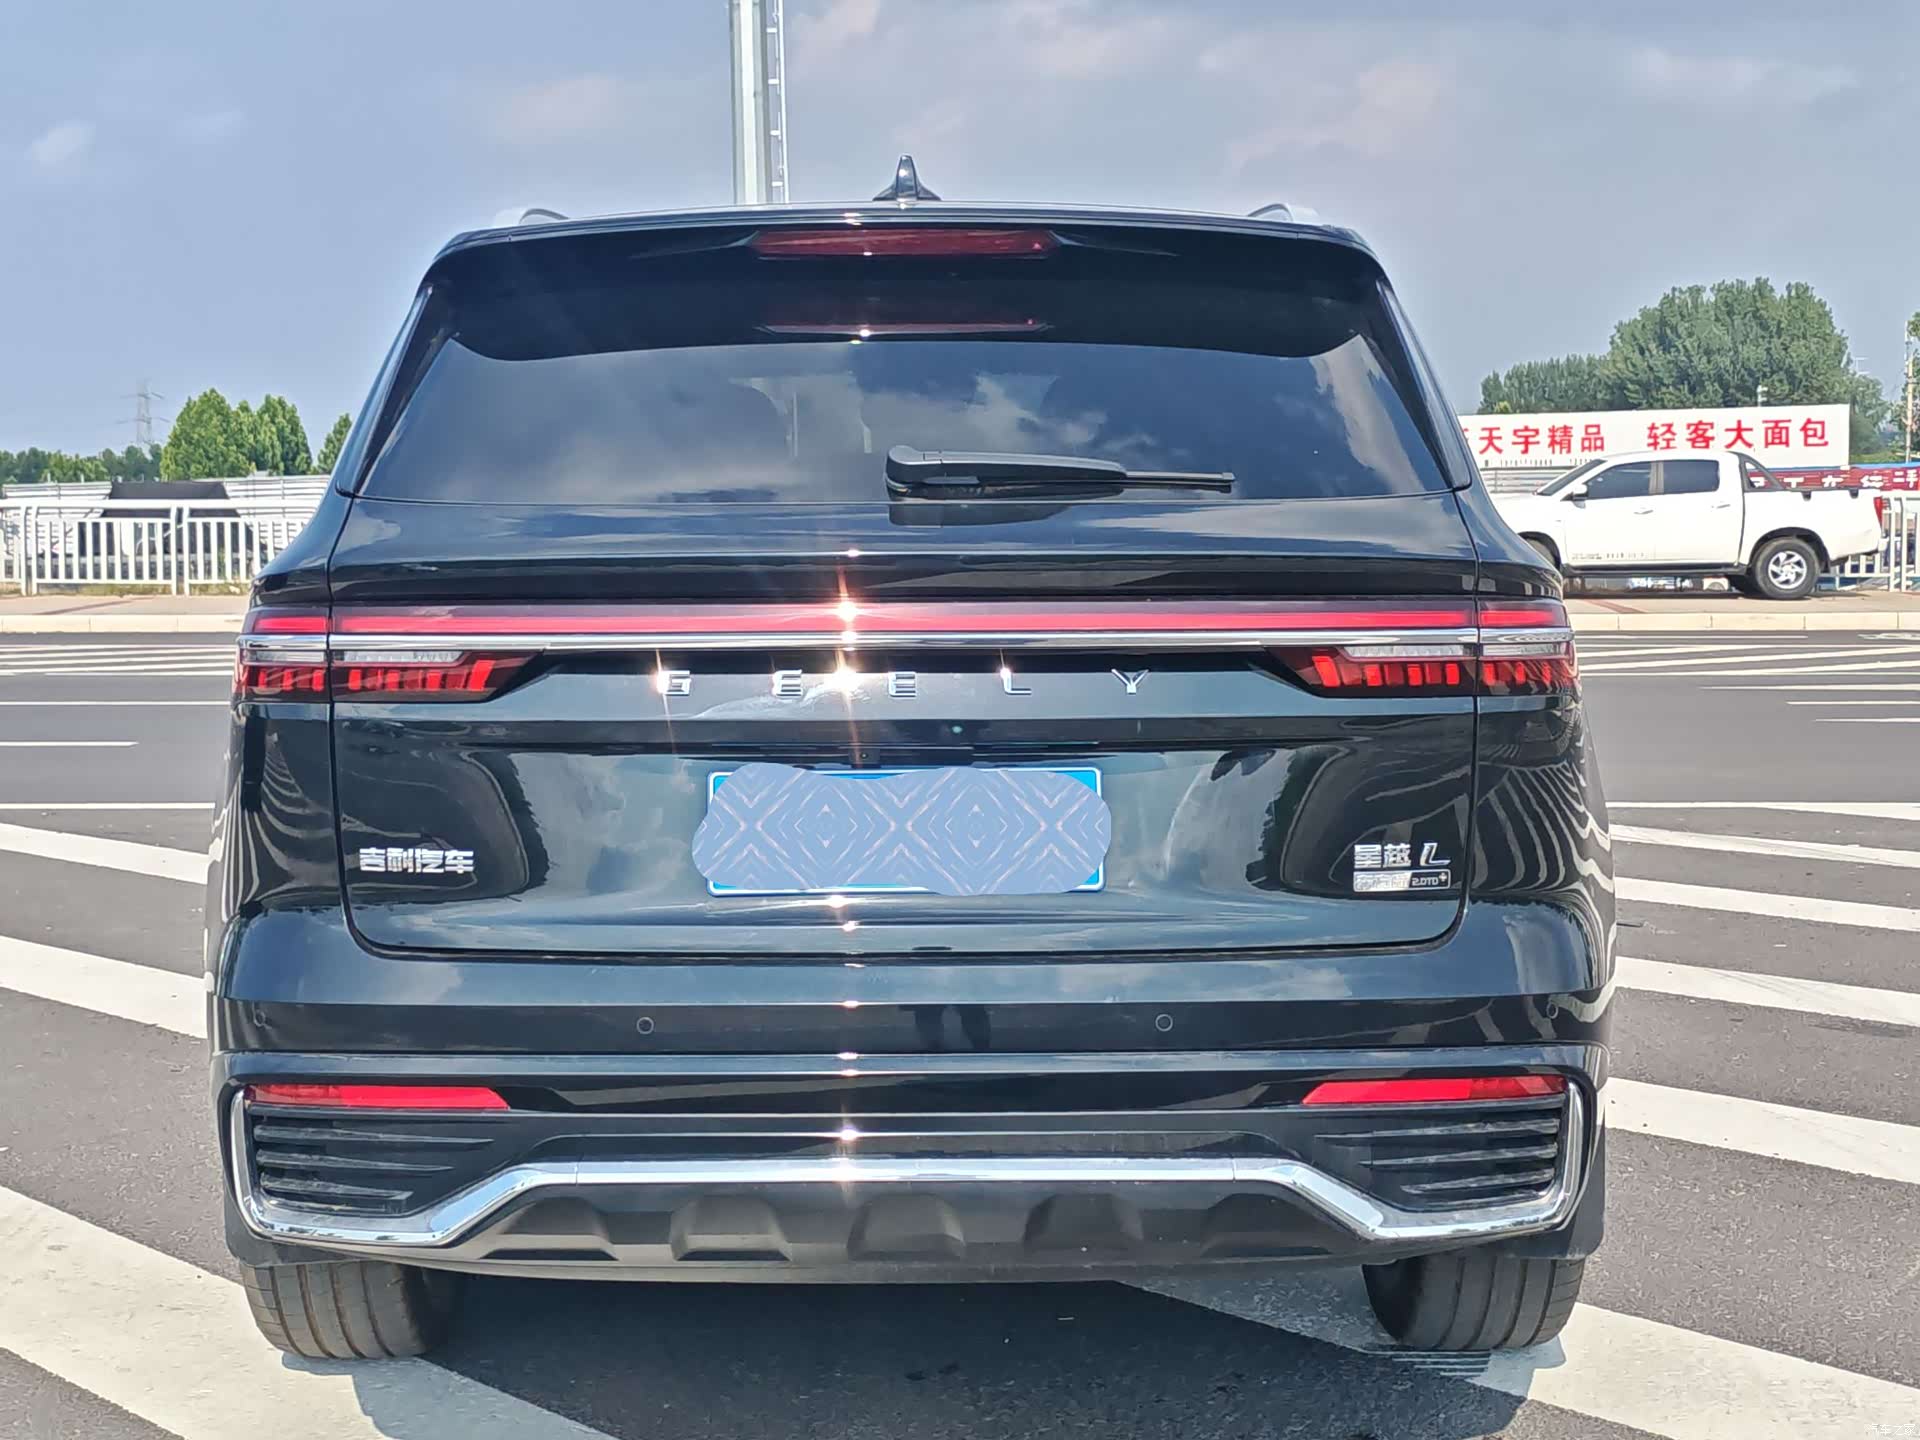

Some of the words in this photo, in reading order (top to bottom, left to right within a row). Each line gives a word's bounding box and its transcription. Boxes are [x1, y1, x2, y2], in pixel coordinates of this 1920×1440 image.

[1647, 417, 1829, 450] 轻客大面包
[656, 668, 1151, 697] GEELY
[359, 847, 474, 874] 吉利汽车
[1354, 843, 1411, 869] 星越
[1420, 842, 1451, 866] L
